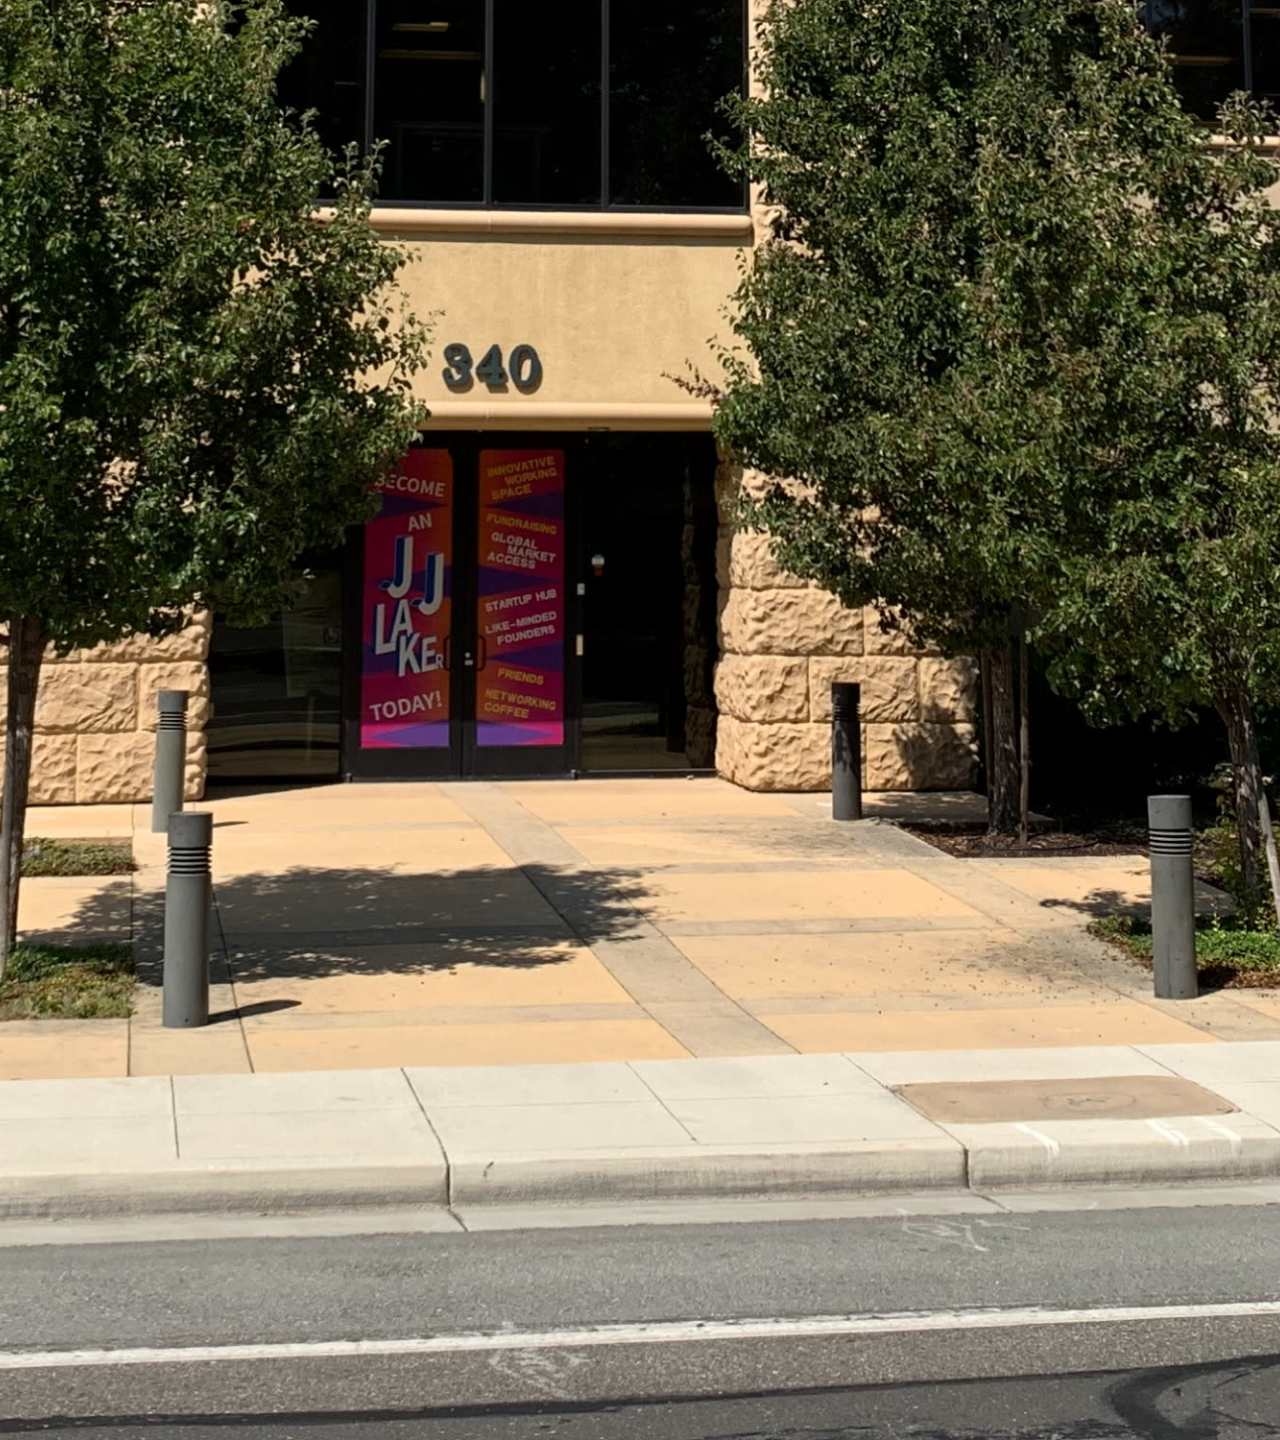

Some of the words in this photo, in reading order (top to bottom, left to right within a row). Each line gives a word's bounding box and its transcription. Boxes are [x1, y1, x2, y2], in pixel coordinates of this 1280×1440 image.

[487, 455, 556, 477] INNOVATIVE
[504, 467, 558, 485] WORKING
[375, 471, 447, 498] BECOME
[491, 483, 533, 500] SPACE
[408, 512, 433, 533] AN
[486, 513, 558, 535] FUNDRAISING
[491, 531, 539, 550] GLOBAL
[488, 551, 536, 570] ACCESS
[507, 545, 557, 564] MARKET
[485, 593, 533, 613] STARTUP
[535, 588, 557, 602] HUB
[485, 611, 557, 634] LIKE-MINDED
[496, 624, 556, 646] FOUNDERS
[497, 667, 544, 685] FRIENDS
[369, 690, 444, 721] TODAY!
[485, 688, 557, 711] NETWORKING
[484, 702, 529, 719] COFFEE
